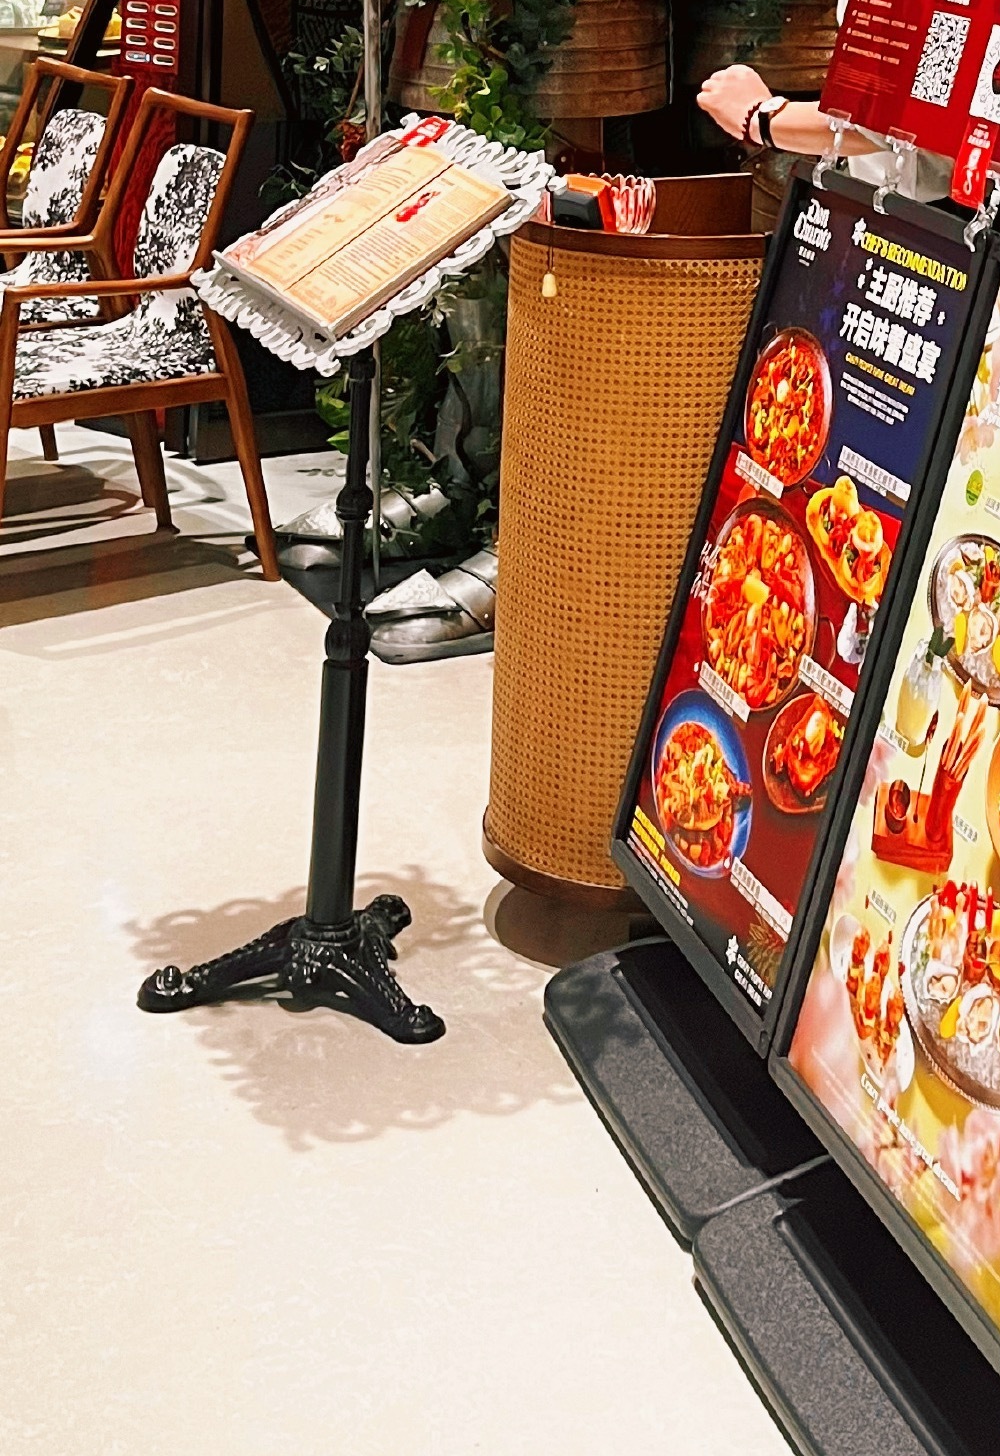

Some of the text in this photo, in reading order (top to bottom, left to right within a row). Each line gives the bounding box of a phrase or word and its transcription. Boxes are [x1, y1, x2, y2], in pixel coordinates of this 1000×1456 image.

[864, 265, 938, 327] 主厨推荐
[839, 302, 942, 384] 开启味蕾盛宴
